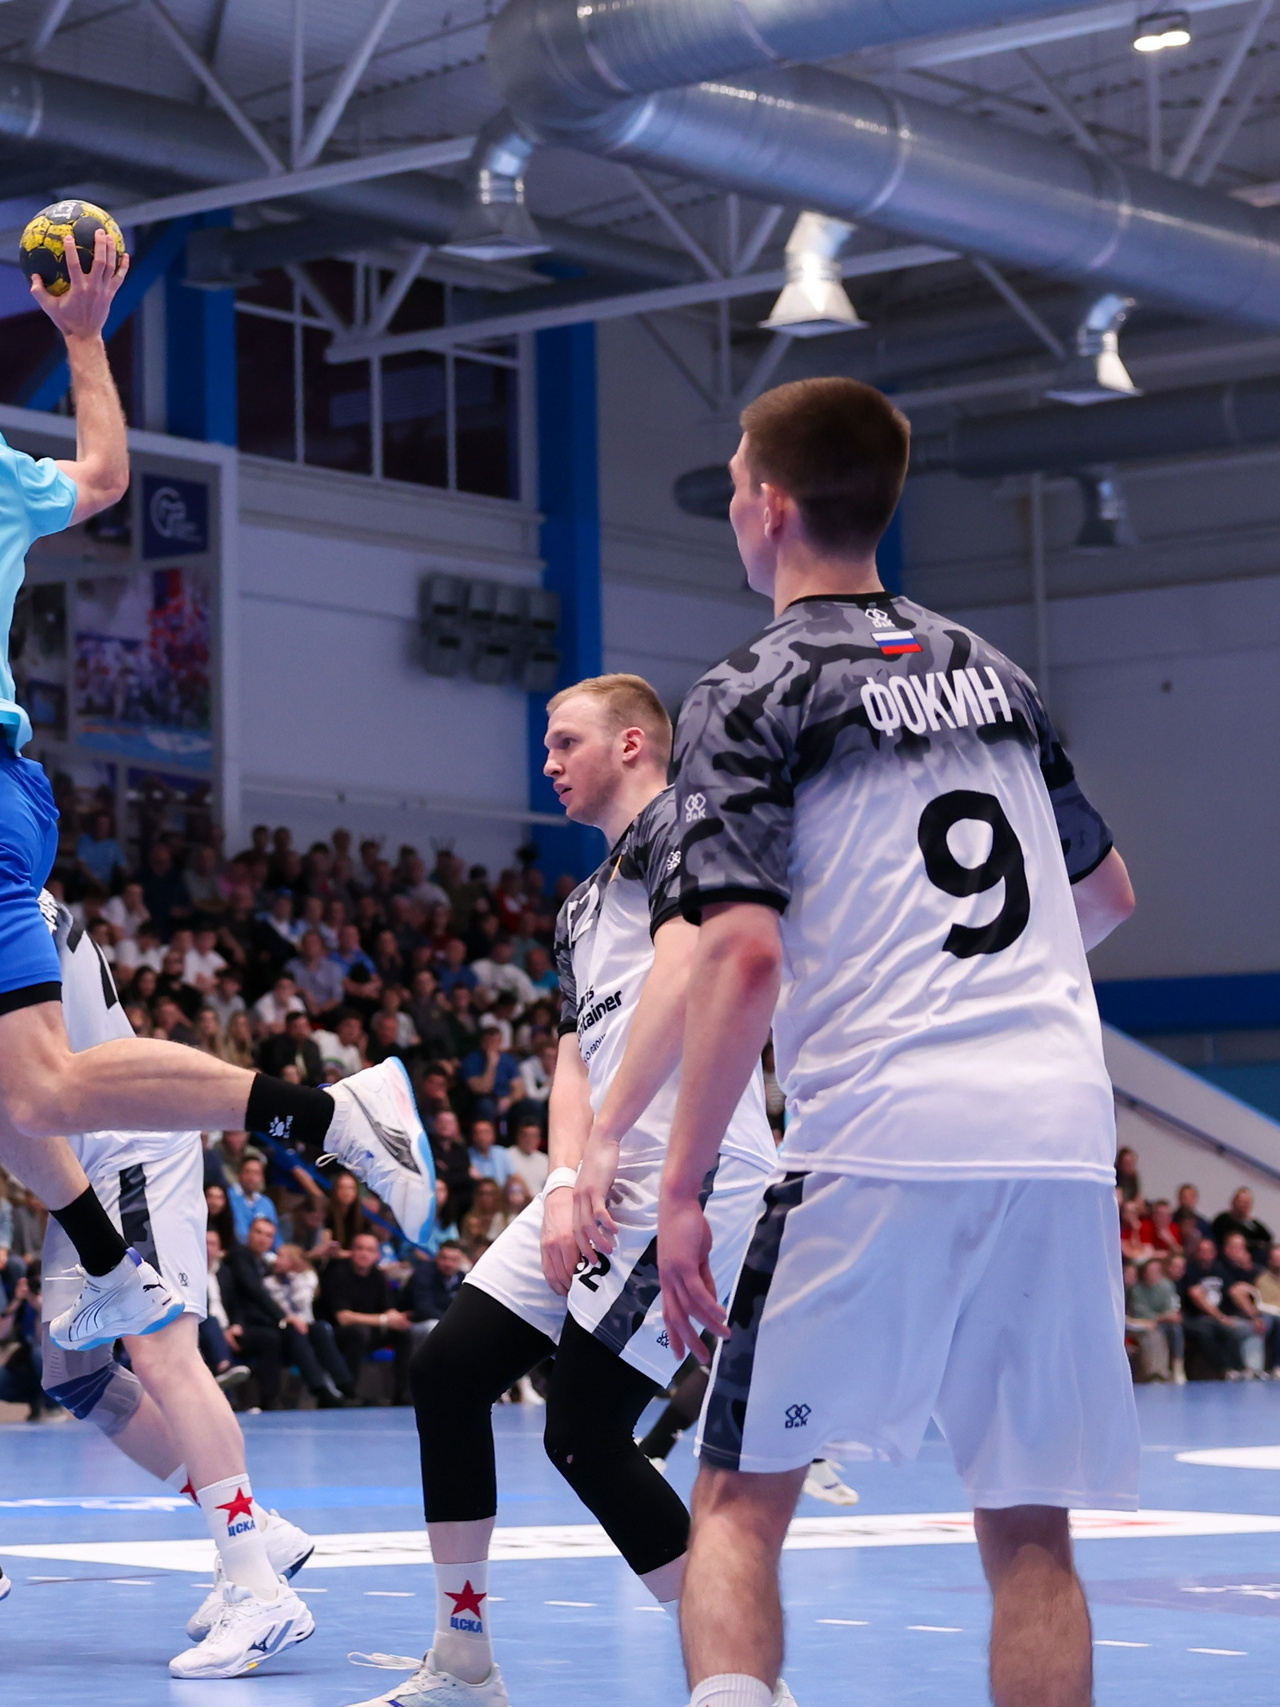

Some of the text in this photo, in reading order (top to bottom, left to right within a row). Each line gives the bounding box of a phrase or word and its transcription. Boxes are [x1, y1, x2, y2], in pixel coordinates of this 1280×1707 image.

[860, 666, 1013, 736] ФОКИН
[917, 789, 1030, 959] 9
[227, 1519, 256, 1537] ЦСКА
[450, 1616, 483, 1633] ЦСКА
